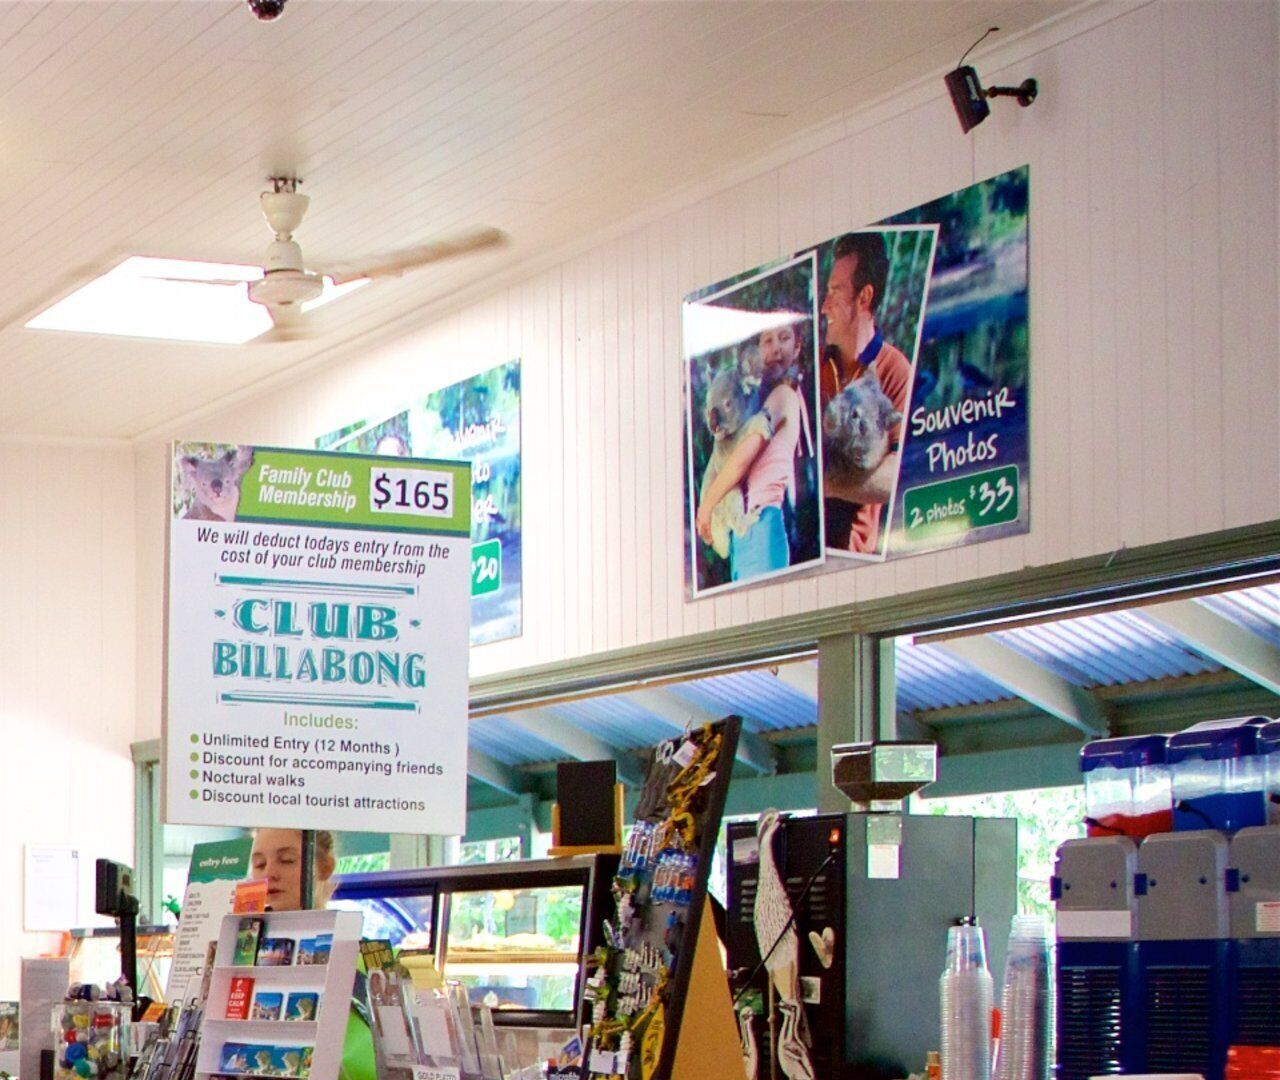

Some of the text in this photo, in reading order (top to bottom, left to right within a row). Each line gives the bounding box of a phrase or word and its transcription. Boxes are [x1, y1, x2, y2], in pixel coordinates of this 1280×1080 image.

[926, 431, 999, 473] Photos
[258, 464, 352, 490] Family Club
[258, 484, 357, 512] Membership
[373, 472, 450, 511] $165
[910, 507, 924, 529] 2
[926, 498, 966, 524] photos
[196, 527, 451, 560] We will deduct todays entry from the
[220, 548, 427, 576] cost of your club membership
[472, 556, 498, 584] 20
[233, 597, 400, 642] CLUB
[211, 640, 427, 689] BILLABONG
[283, 711, 360, 731] Includes:
[202, 733, 269, 750] Unlimited
[273, 735, 311, 755] Entry
[314, 738, 336, 755] (12
[340, 740, 391, 756] Months
[202, 751, 444, 777] Discount for accompanying friends
[202, 770, 306, 788] Noctural walks
[202, 788, 426, 812] Discount local tourist attractions
[199, 856, 239, 868] entry fees
